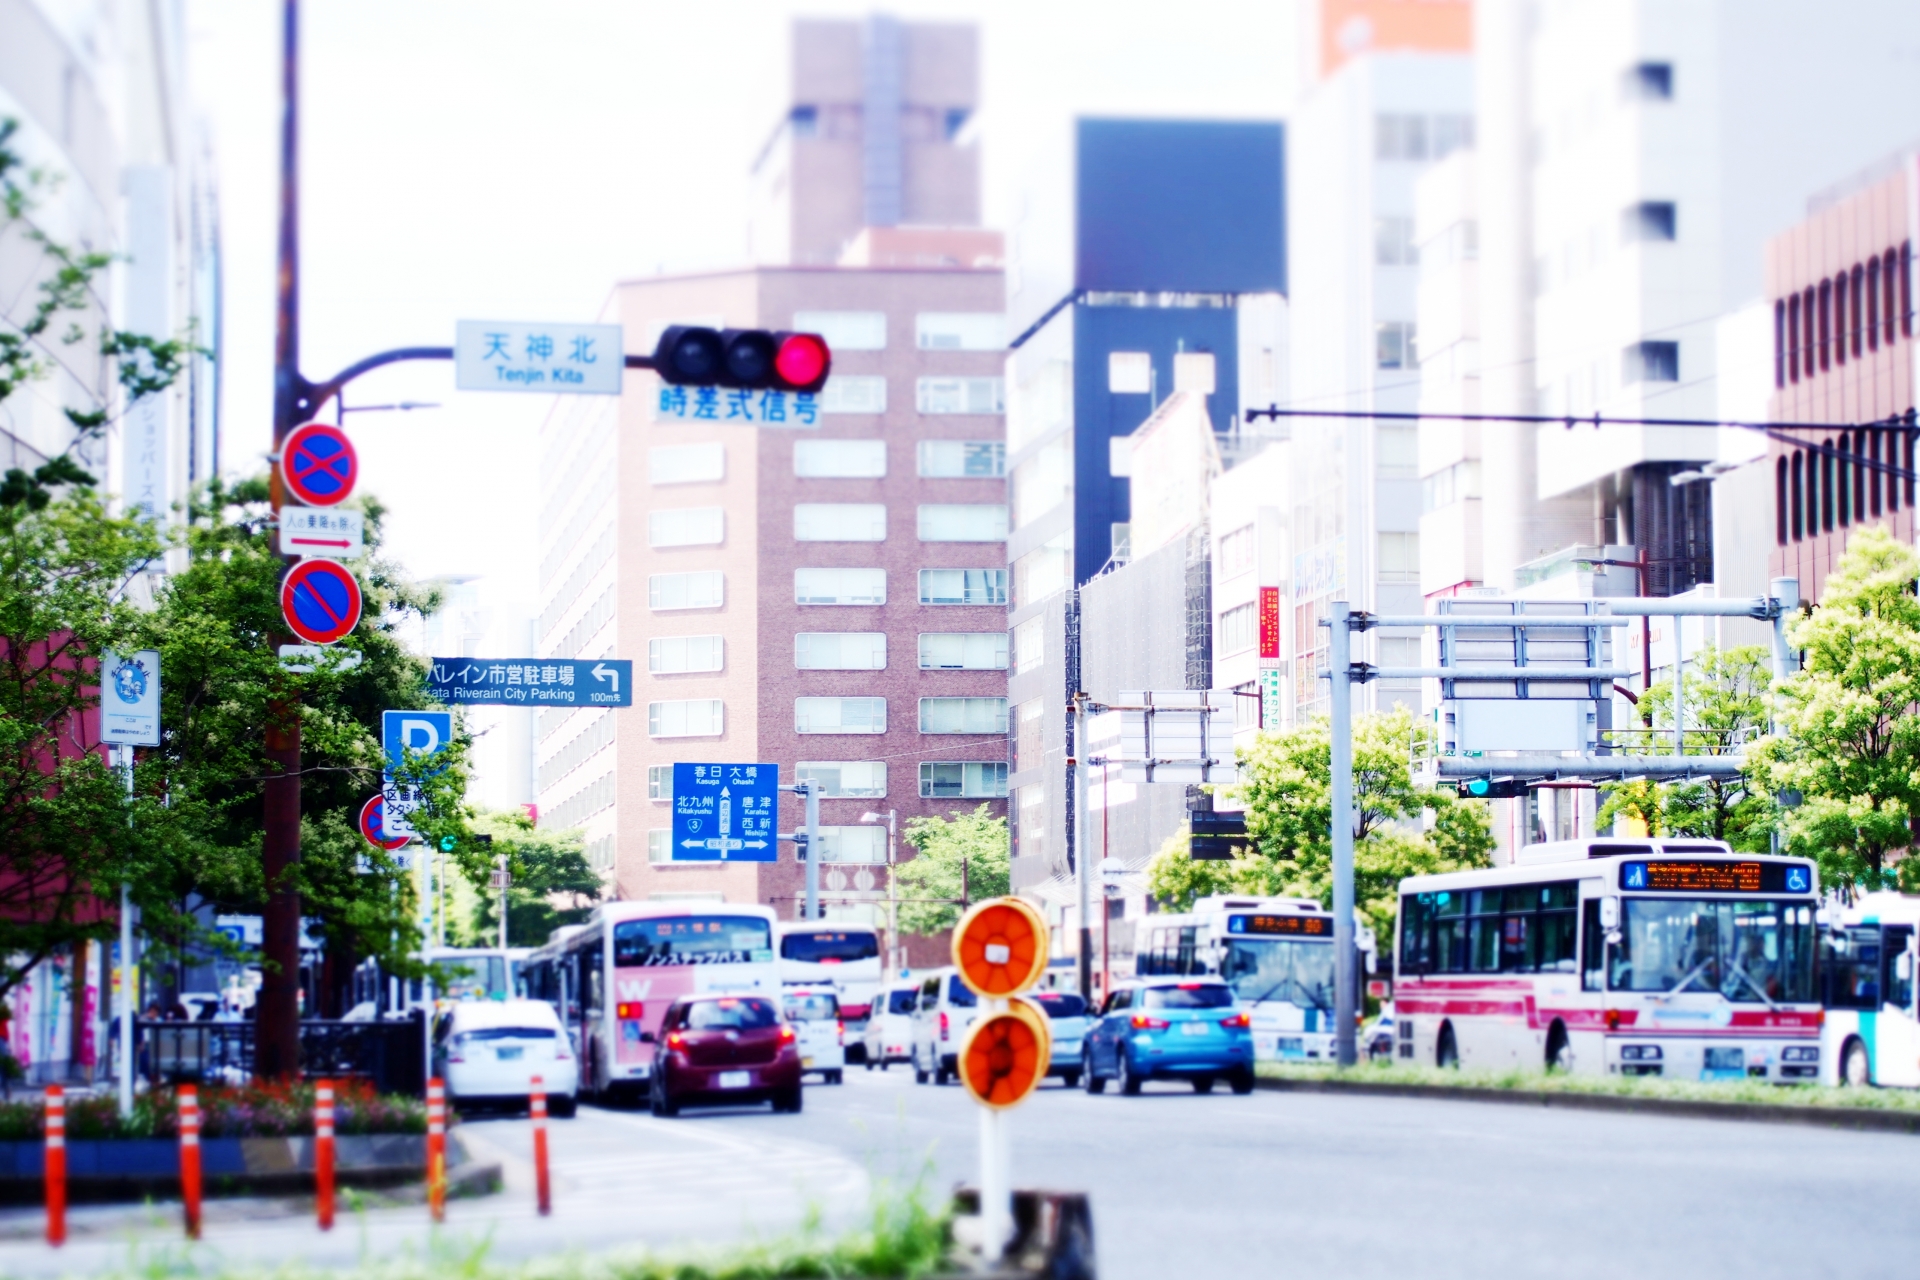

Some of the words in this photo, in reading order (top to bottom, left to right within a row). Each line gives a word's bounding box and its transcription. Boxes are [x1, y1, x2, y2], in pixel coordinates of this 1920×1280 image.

[482, 332, 597, 364] 天神北
[495, 365, 545, 385] Tenjin
[552, 366, 584, 384] Kita
[659, 386, 820, 425] 時差式信号
[286, 513, 357, 532] 人の乗降を除く
[425, 663, 575, 686] バレイン市営駐車場
[454, 687, 500, 698] Riverain
[504, 688, 527, 701] City
[531, 688, 575, 701] Parking
[590, 692, 621, 702] 100m先
[402, 719, 439, 758] P
[694, 765, 722, 778] 春日
[729, 766, 758, 778] 大橋
[696, 778, 720, 786] Kasuga
[677, 795, 714, 807] 北九州
[742, 796, 772, 808] 唐津
[691, 820, 699, 829] 3
[742, 817, 771, 829] 西新
[744, 829, 768, 837] Nishijin
[644, 950, 745, 967] ノンステップバス
